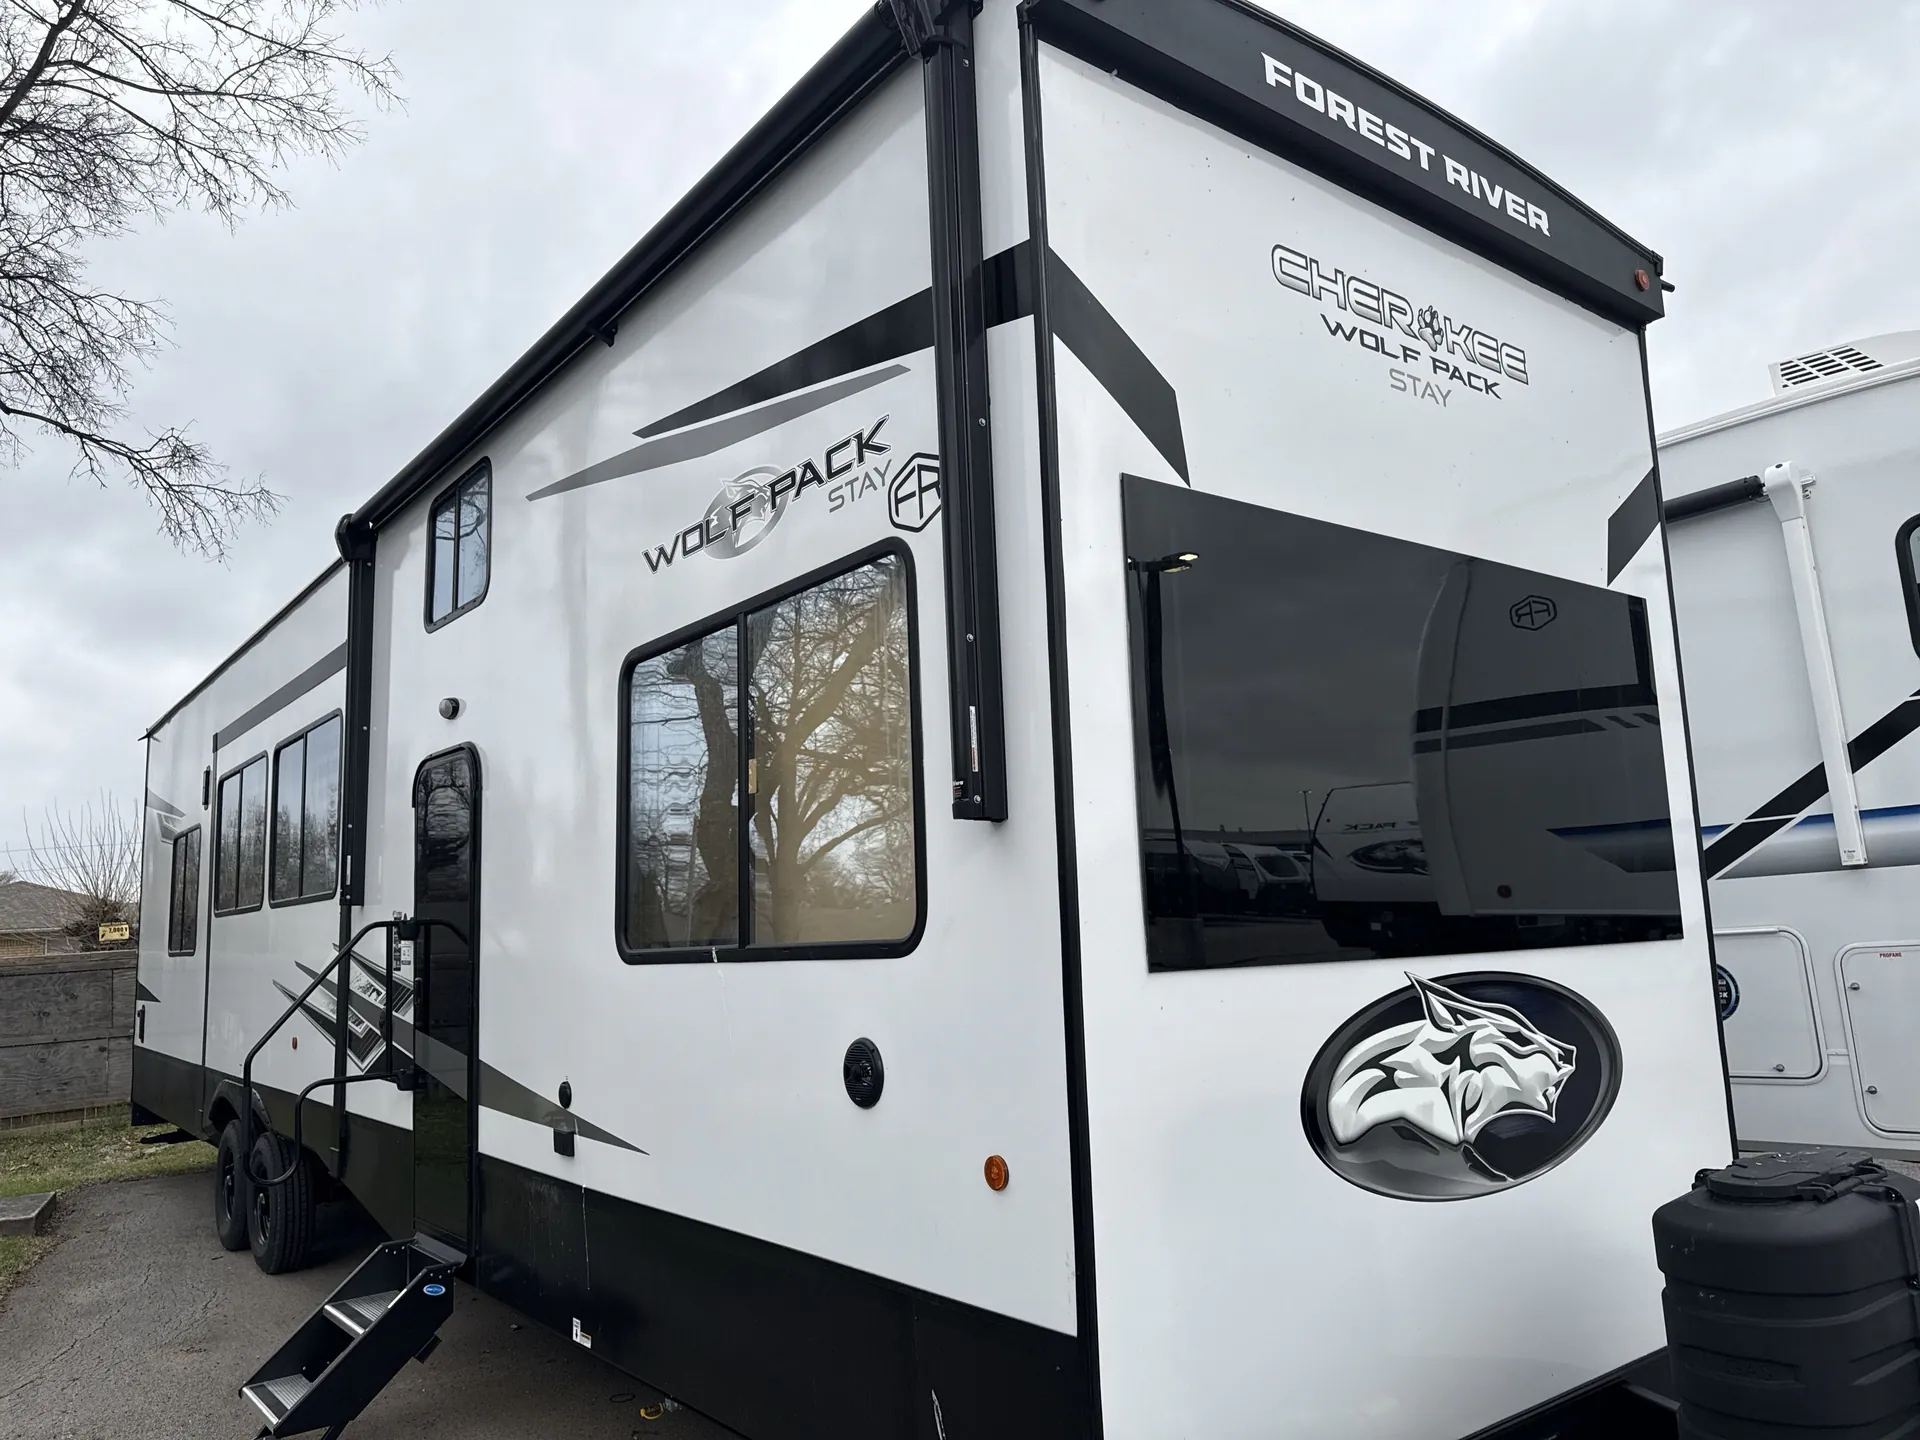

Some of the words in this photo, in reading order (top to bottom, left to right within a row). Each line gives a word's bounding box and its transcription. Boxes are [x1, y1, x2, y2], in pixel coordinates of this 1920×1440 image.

[1261, 52, 1435, 171] FOREST
[1442, 154, 1551, 237] RIVER
[1320, 313, 1421, 362] WOLF
[1430, 356, 1502, 400] PACK
[1389, 368, 1452, 407] STAY
[641, 493, 755, 574] WOLF
[767, 414, 891, 511] PACK
[828, 459, 892, 513] STAY
